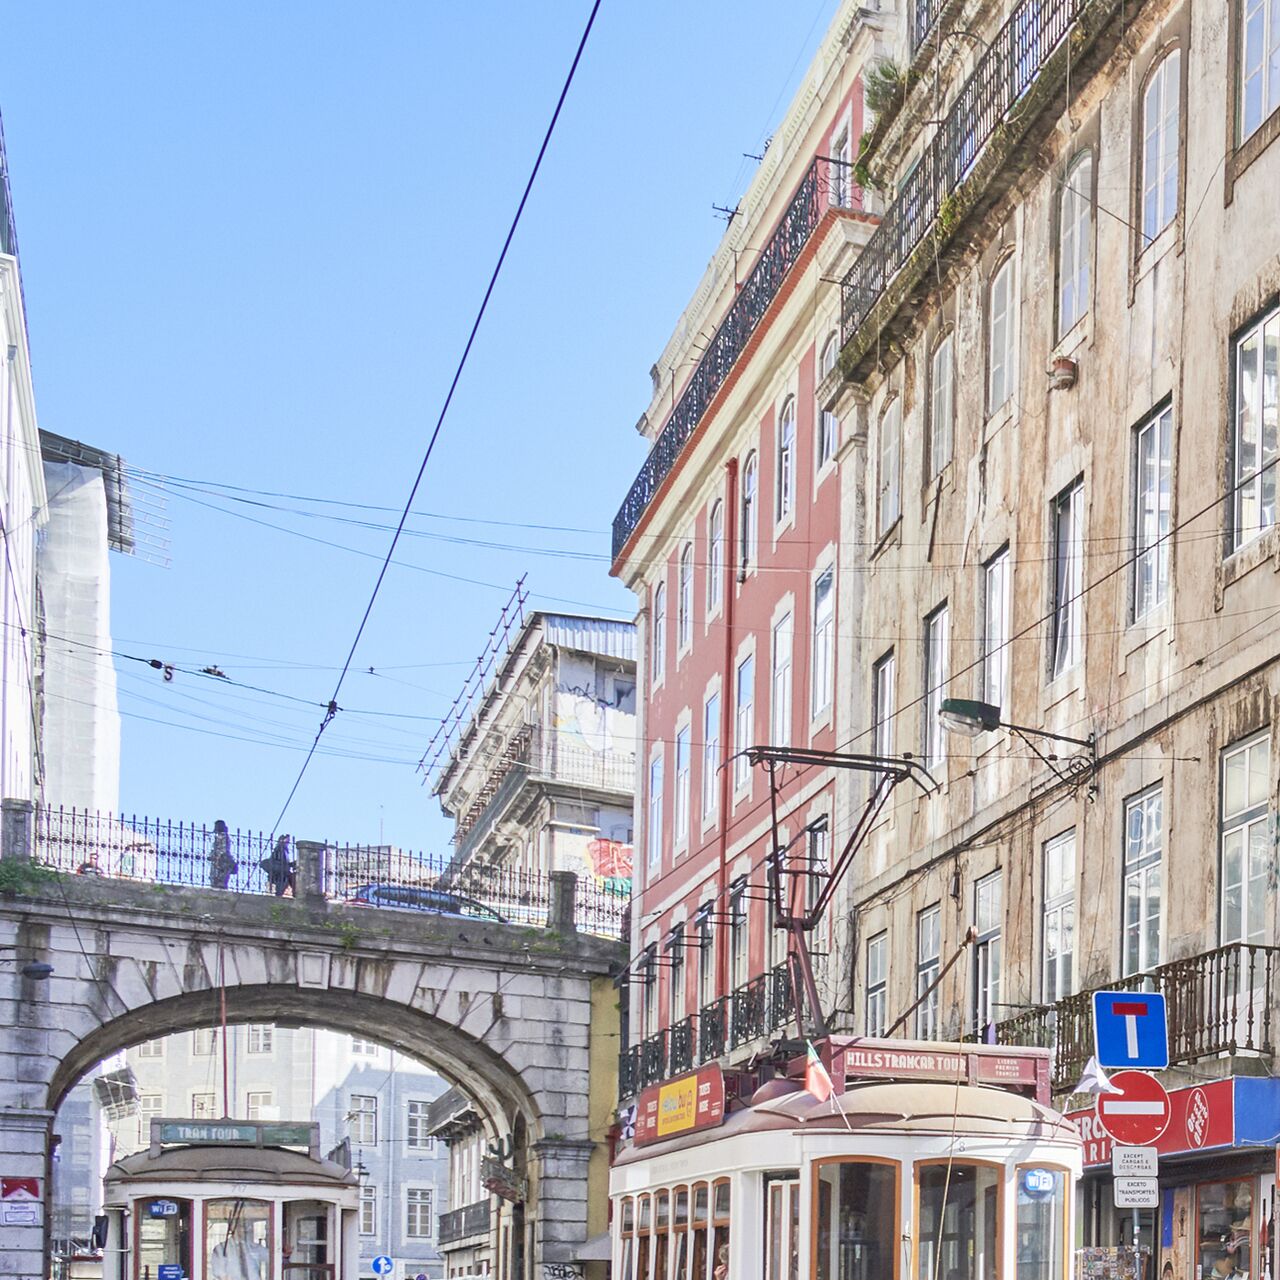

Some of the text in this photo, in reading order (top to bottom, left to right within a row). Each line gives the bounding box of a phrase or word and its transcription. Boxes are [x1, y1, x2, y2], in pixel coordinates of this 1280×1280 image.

[847, 1052, 966, 1072] HILLS TRAMCAR TOUR
[177, 1127, 240, 1140] TRAM TOUR
